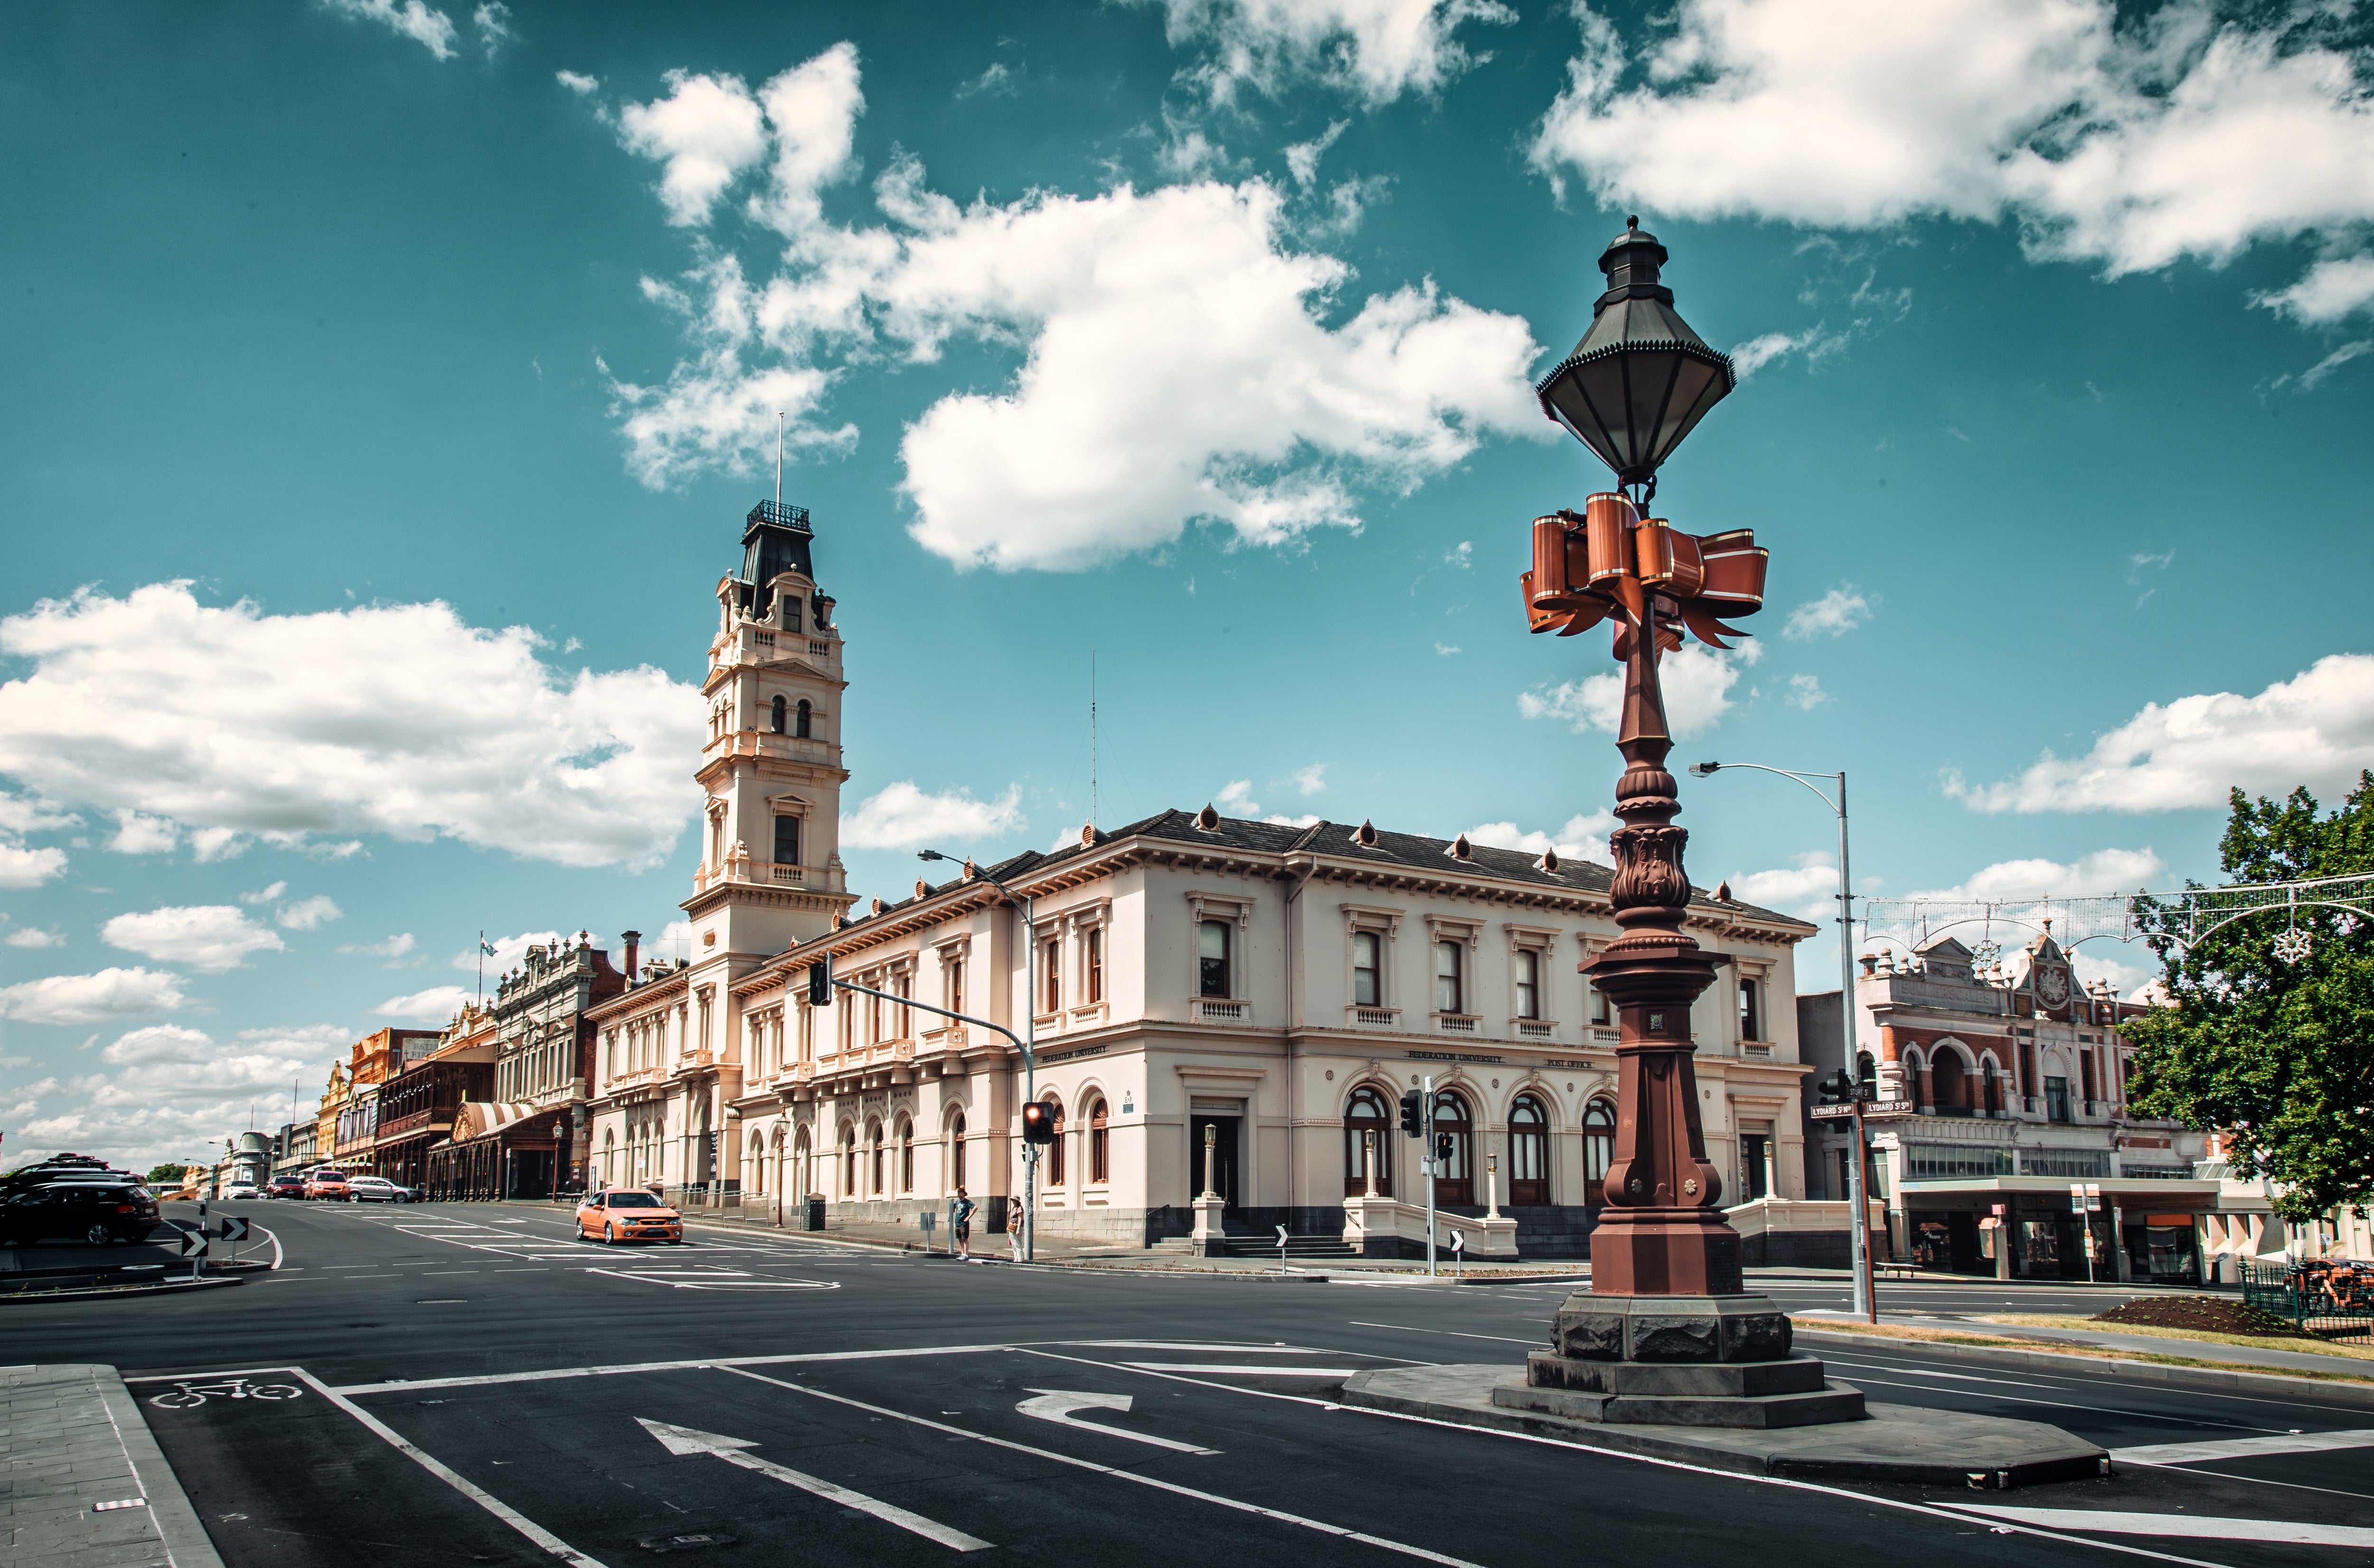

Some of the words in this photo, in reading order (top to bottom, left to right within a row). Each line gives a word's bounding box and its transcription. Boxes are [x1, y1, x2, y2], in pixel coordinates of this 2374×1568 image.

[1042, 1052, 1073, 1063] FEDERATION
[1075, 1045, 1106, 1057] UNIVERSITY
[1409, 1050, 1456, 1060] FEDERATION
[1458, 1054, 1503, 1063] UNIVERSITY
[1567, 1060, 1592, 1069] OFFICE
[1813, 1107, 1837, 1116] LYDIARD
[1868, 1103, 1894, 1111] LYDIARD
